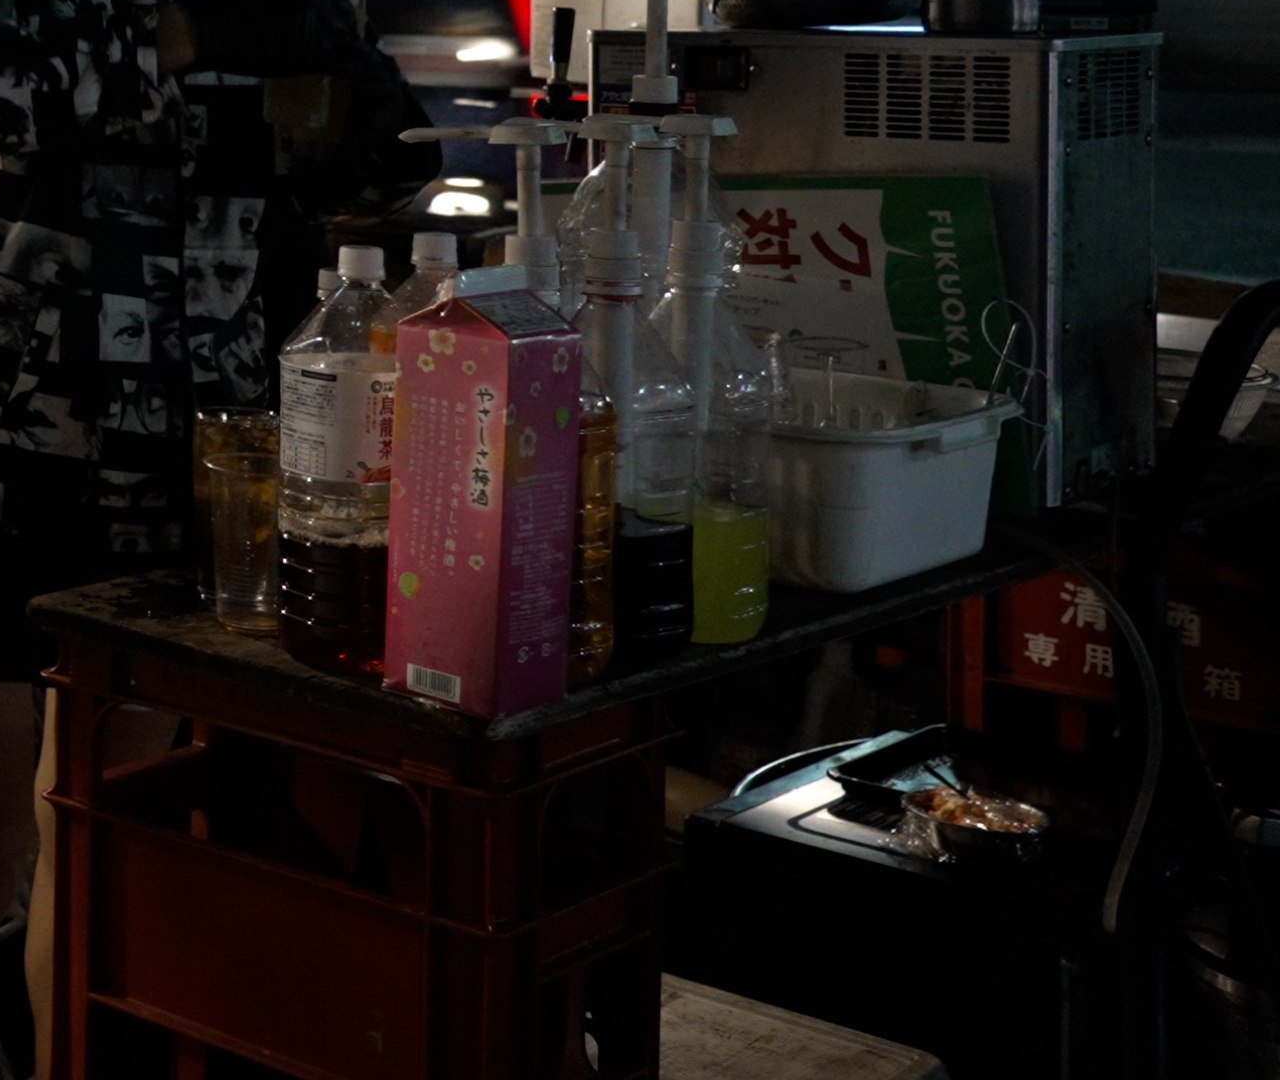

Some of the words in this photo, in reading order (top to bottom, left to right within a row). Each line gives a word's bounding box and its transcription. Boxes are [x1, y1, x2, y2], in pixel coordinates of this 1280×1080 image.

[927, 209, 972, 367] FUKUOKA
[471, 387, 494, 507] やさしさ梅酒
